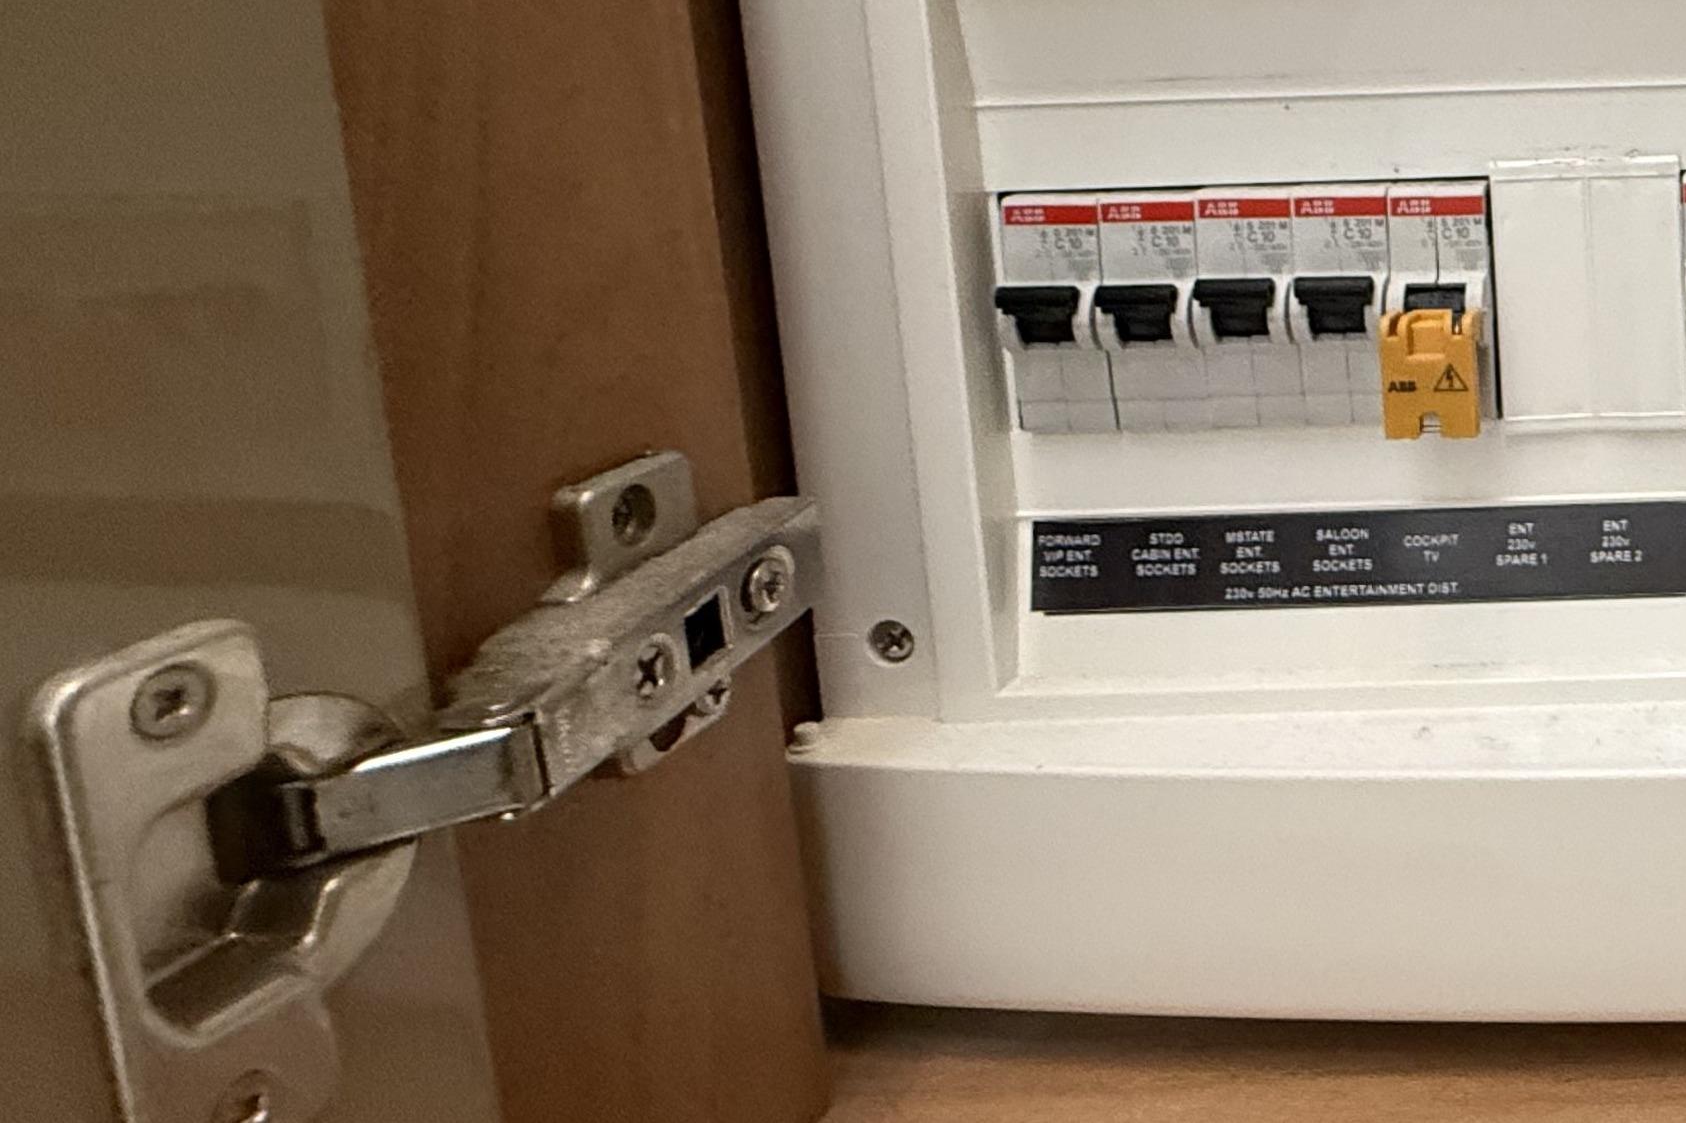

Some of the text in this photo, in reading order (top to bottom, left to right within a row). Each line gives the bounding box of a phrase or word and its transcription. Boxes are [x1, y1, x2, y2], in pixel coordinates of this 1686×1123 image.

[1301, 200, 1334, 214] ABB
[1397, 200, 1431, 213] ABB
[1107, 206, 1141, 220] ABB
[1388, 381, 1416, 393] ABB
[1509, 523, 1534, 535] ENT
[1603, 520, 1628, 532] ENT
[1038, 534, 1101, 547] FORWARD
[1316, 529, 1369, 541] SALOON
[1403, 534, 1458, 547] COCKPIT
[1507, 539, 1535, 550] 230v
[1602, 536, 1630, 548] 230v
[1043, 550, 1063, 562] VIP
[1131, 549, 1170, 561] CABIN
[1424, 550, 1439, 562] TV
[1496, 554, 1547, 566] SPARE 1
[1590, 551, 1643, 563] SPARE 2
[1136, 564, 1196, 576] SOCKETS
[1220, 562, 1280, 574] SOCKETS
[1312, 559, 1372, 571] SOCKETS
[1039, 565, 1098, 578] SOCKETS
[1291, 586, 1310, 597] AC
[1314, 583, 1424, 597] ENTERTAINMENT
